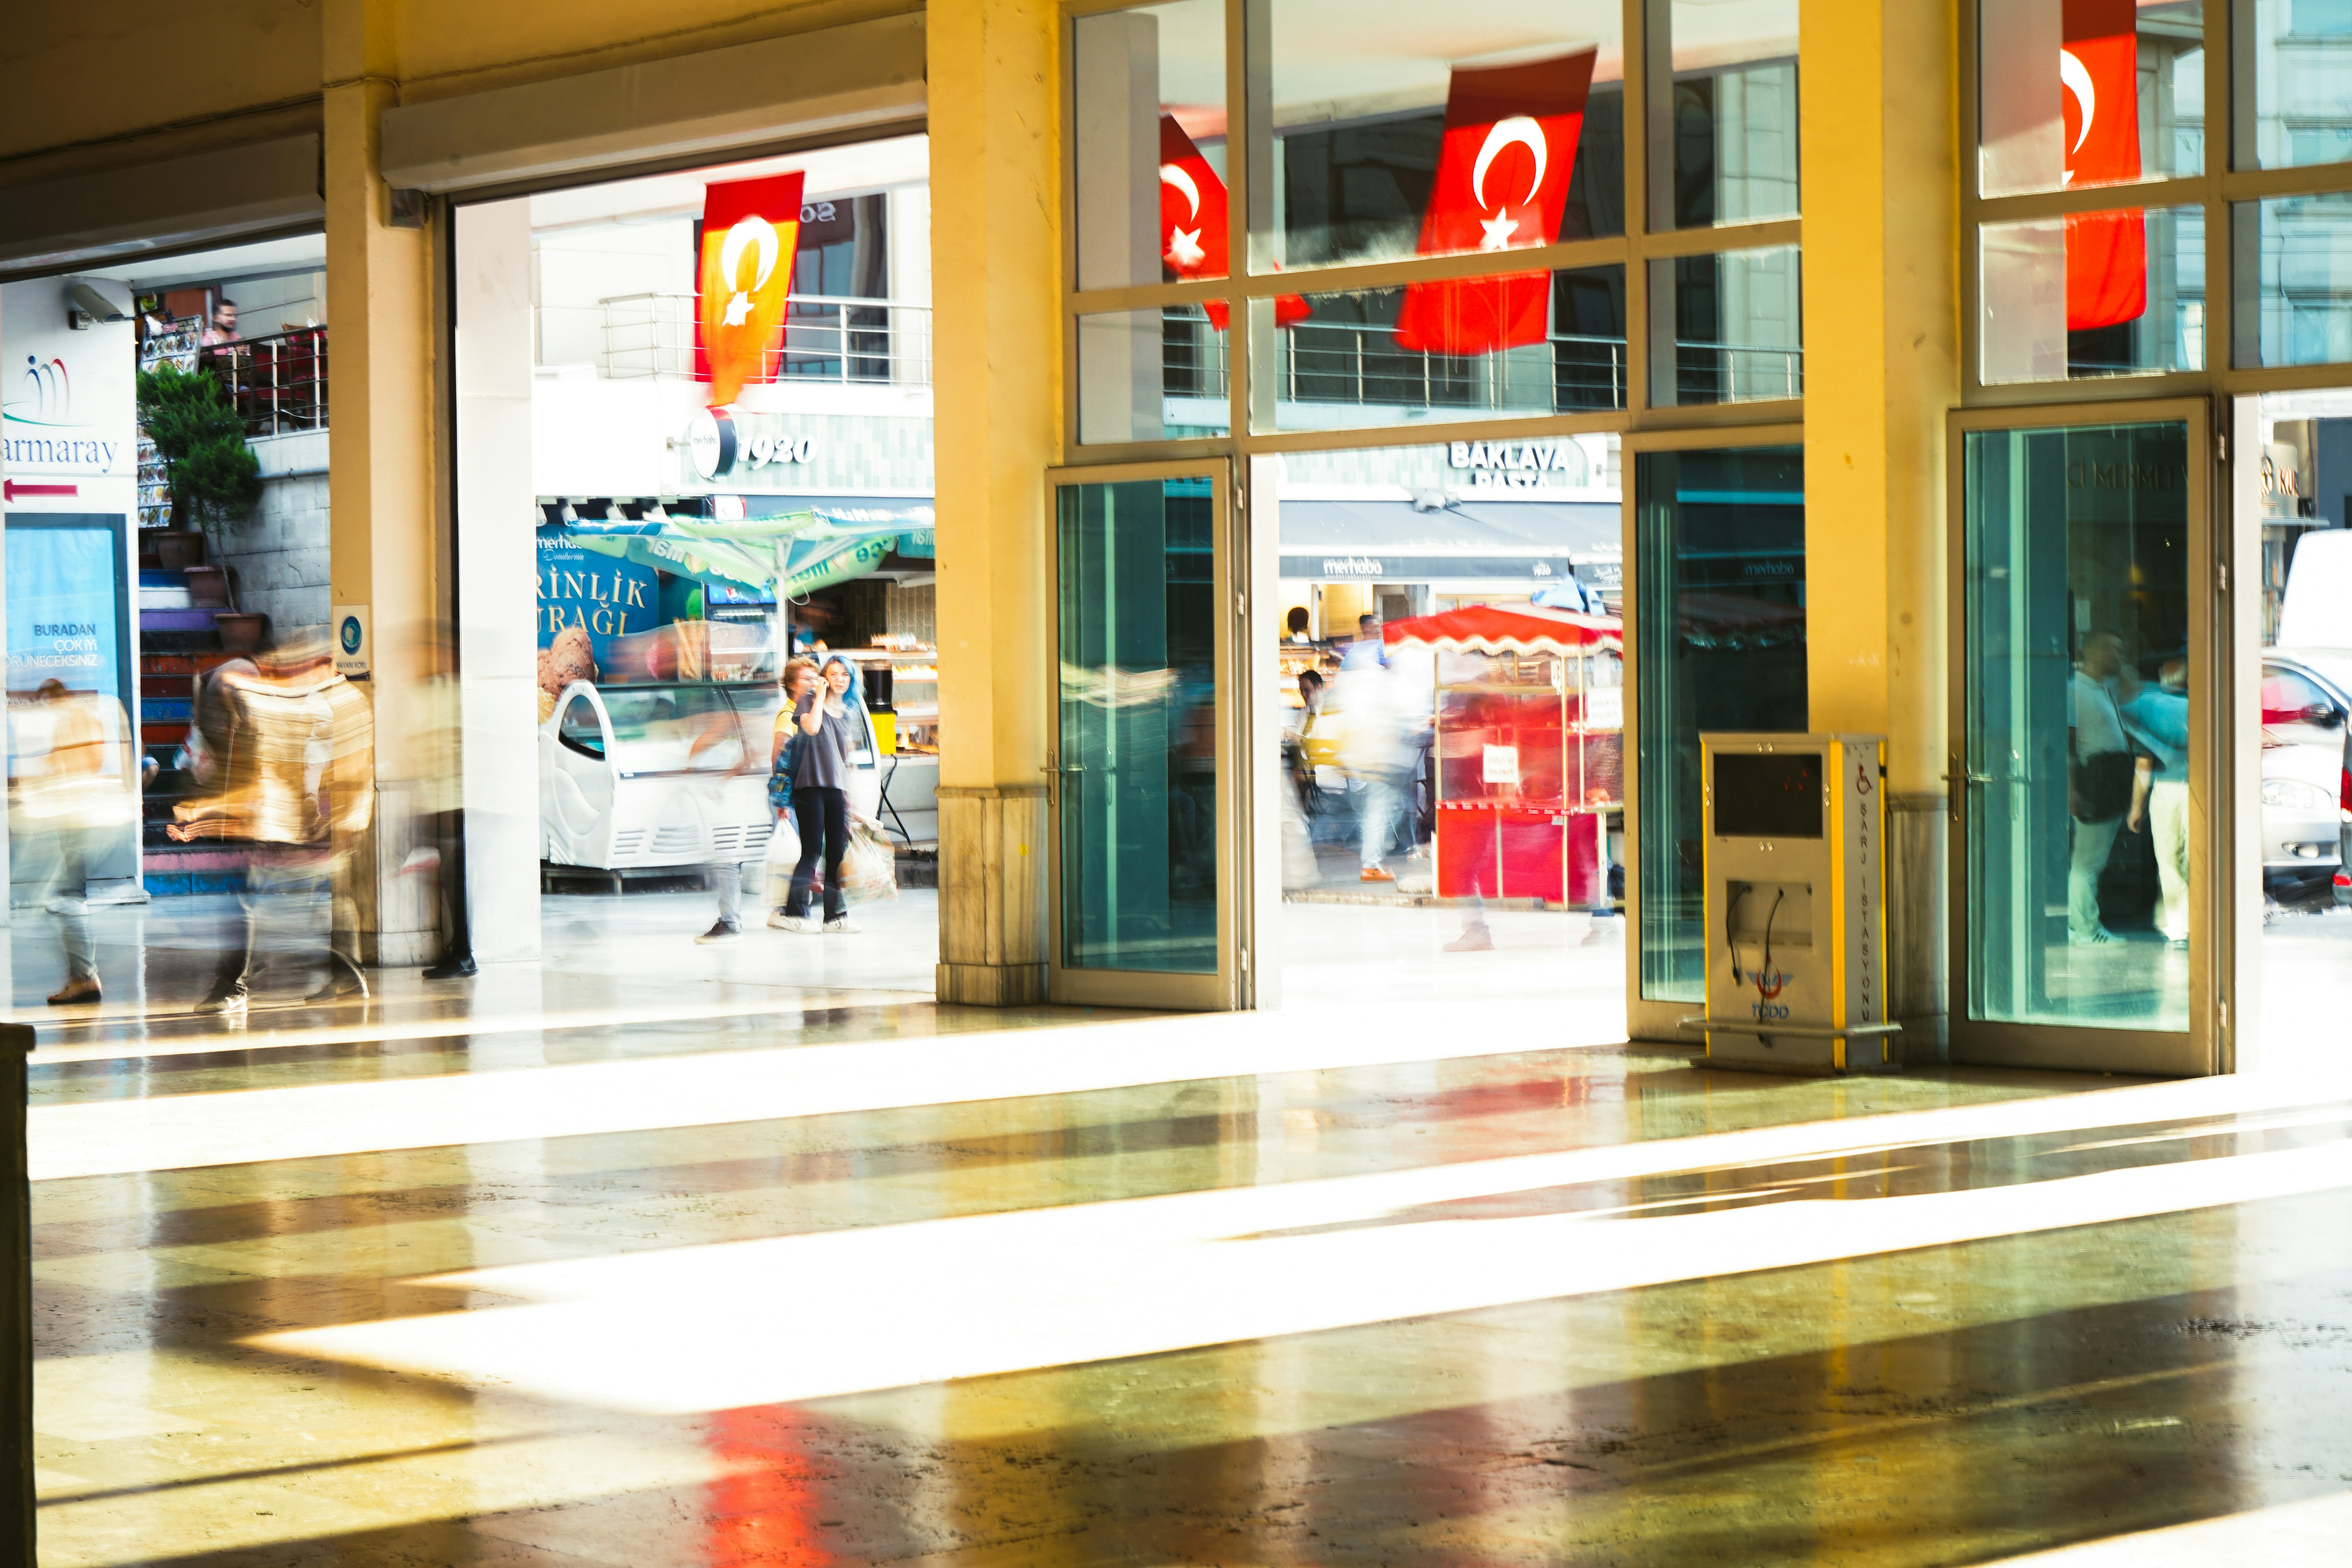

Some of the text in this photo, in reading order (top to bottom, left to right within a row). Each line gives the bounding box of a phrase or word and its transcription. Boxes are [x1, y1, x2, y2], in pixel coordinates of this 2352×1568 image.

[739, 432, 818, 470] 1920
[1450, 440, 1570, 471] BAKLAVA
[1323, 556, 1383, 575] merhaba
[1744, 560, 1795, 575] merhaba
[34, 624, 96, 636] BURADAN
[54, 639, 83, 655] ÇOK
[1751, 1003, 1790, 1020] TCDD
